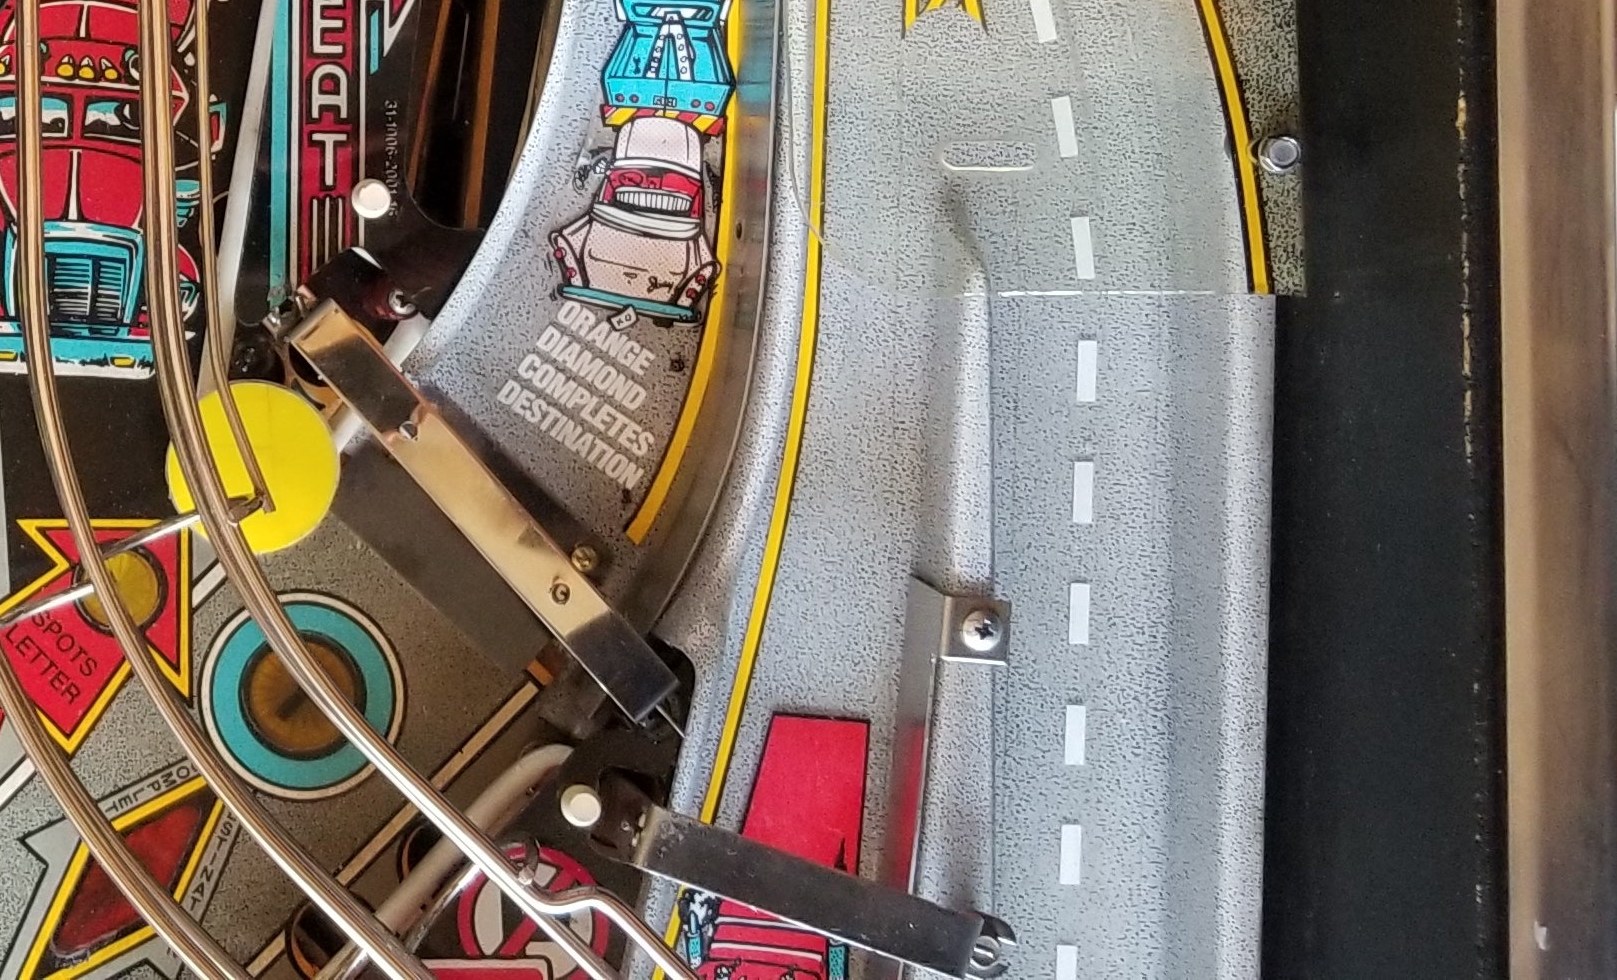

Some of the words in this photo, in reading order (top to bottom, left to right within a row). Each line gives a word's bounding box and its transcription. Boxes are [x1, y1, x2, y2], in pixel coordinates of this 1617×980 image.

[535, 324, 647, 411] DIAMOND
[557, 301, 656, 376] ORANGE
[497, 378, 645, 491] DESTINATION
[517, 353, 655, 457] COMPLETES
[4, 623, 82, 705] LETTER
[32, 611, 99, 677] SPOTS
[104, 761, 199, 817] OMPLET
